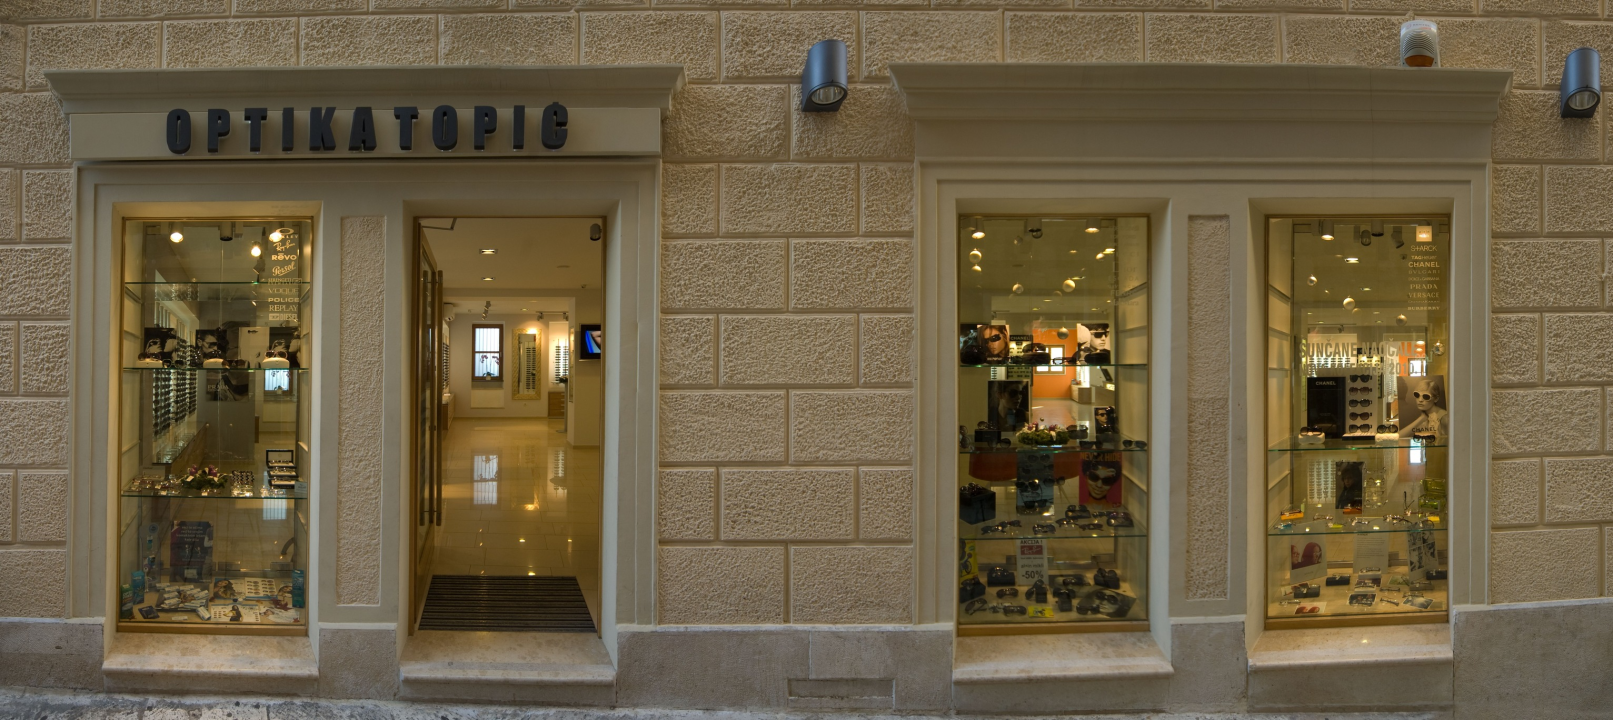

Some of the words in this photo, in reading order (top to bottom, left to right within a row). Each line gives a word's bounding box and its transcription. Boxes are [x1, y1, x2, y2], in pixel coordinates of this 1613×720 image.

[166, 106, 378, 155] OPTIKA
[393, 102, 569, 152] TOPIĆ
[269, 304, 298, 312] REPLAY
[1299, 339, 1357, 358] SUNČANE
[1081, 453, 1102, 462] NEVR
[1105, 453, 1122, 462] HIDE
[1021, 570, 1044, 580] -50%
